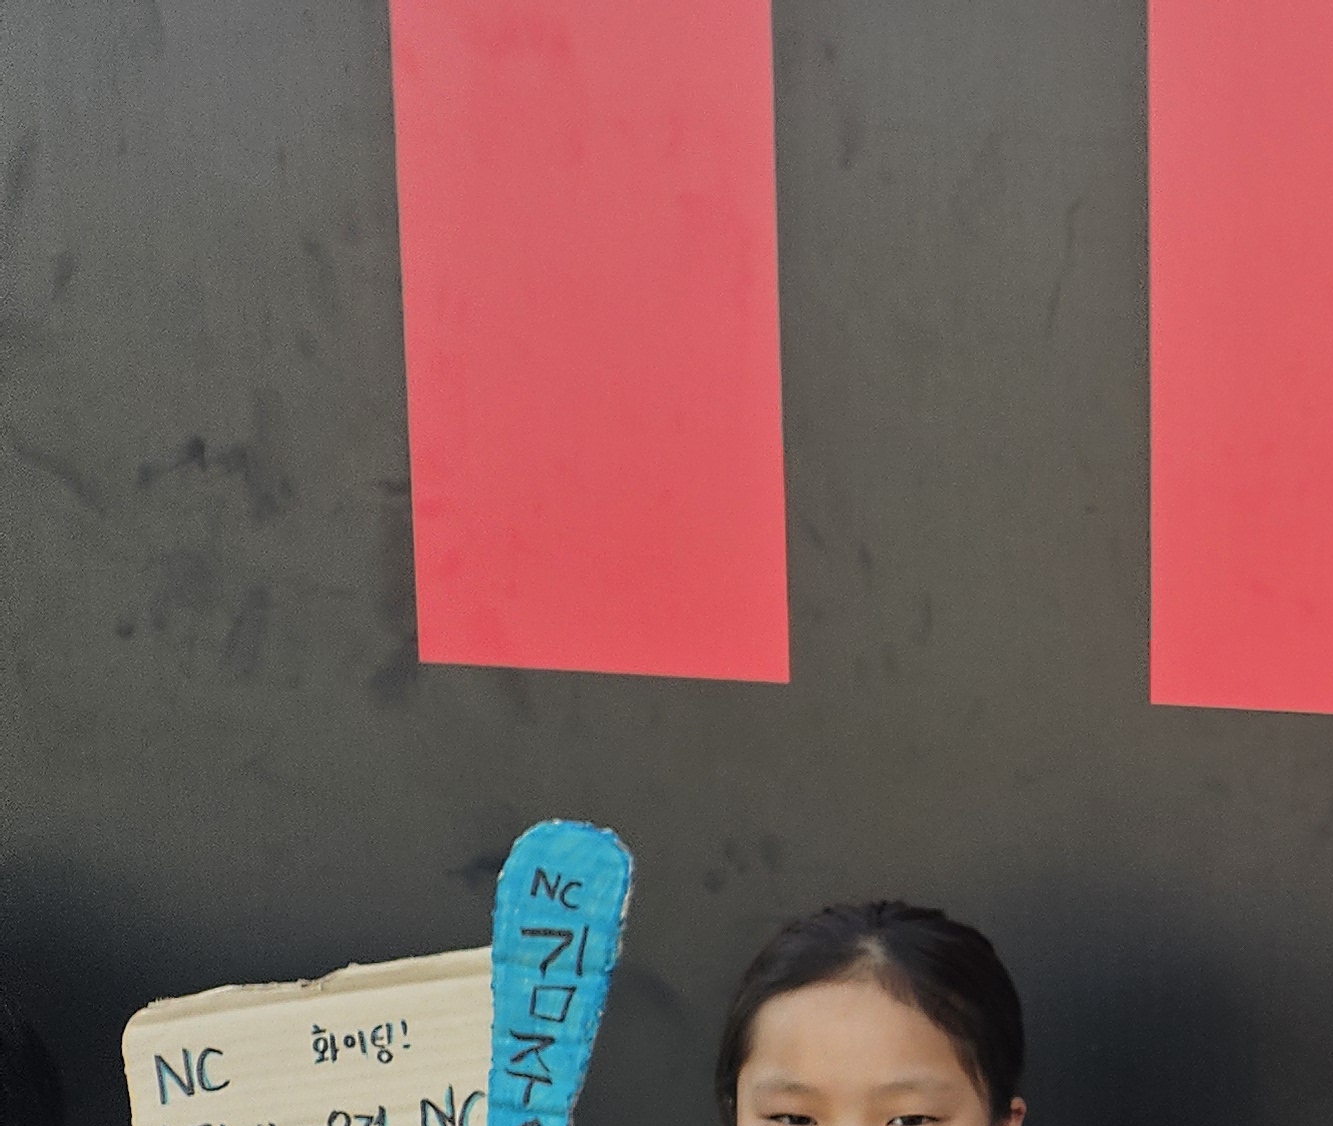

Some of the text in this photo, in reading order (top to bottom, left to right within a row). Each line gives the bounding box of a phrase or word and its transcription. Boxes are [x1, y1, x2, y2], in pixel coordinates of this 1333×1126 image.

[530, 867, 582, 909] NC
[156, 1020, 411, 1105] NC 화이팅!
